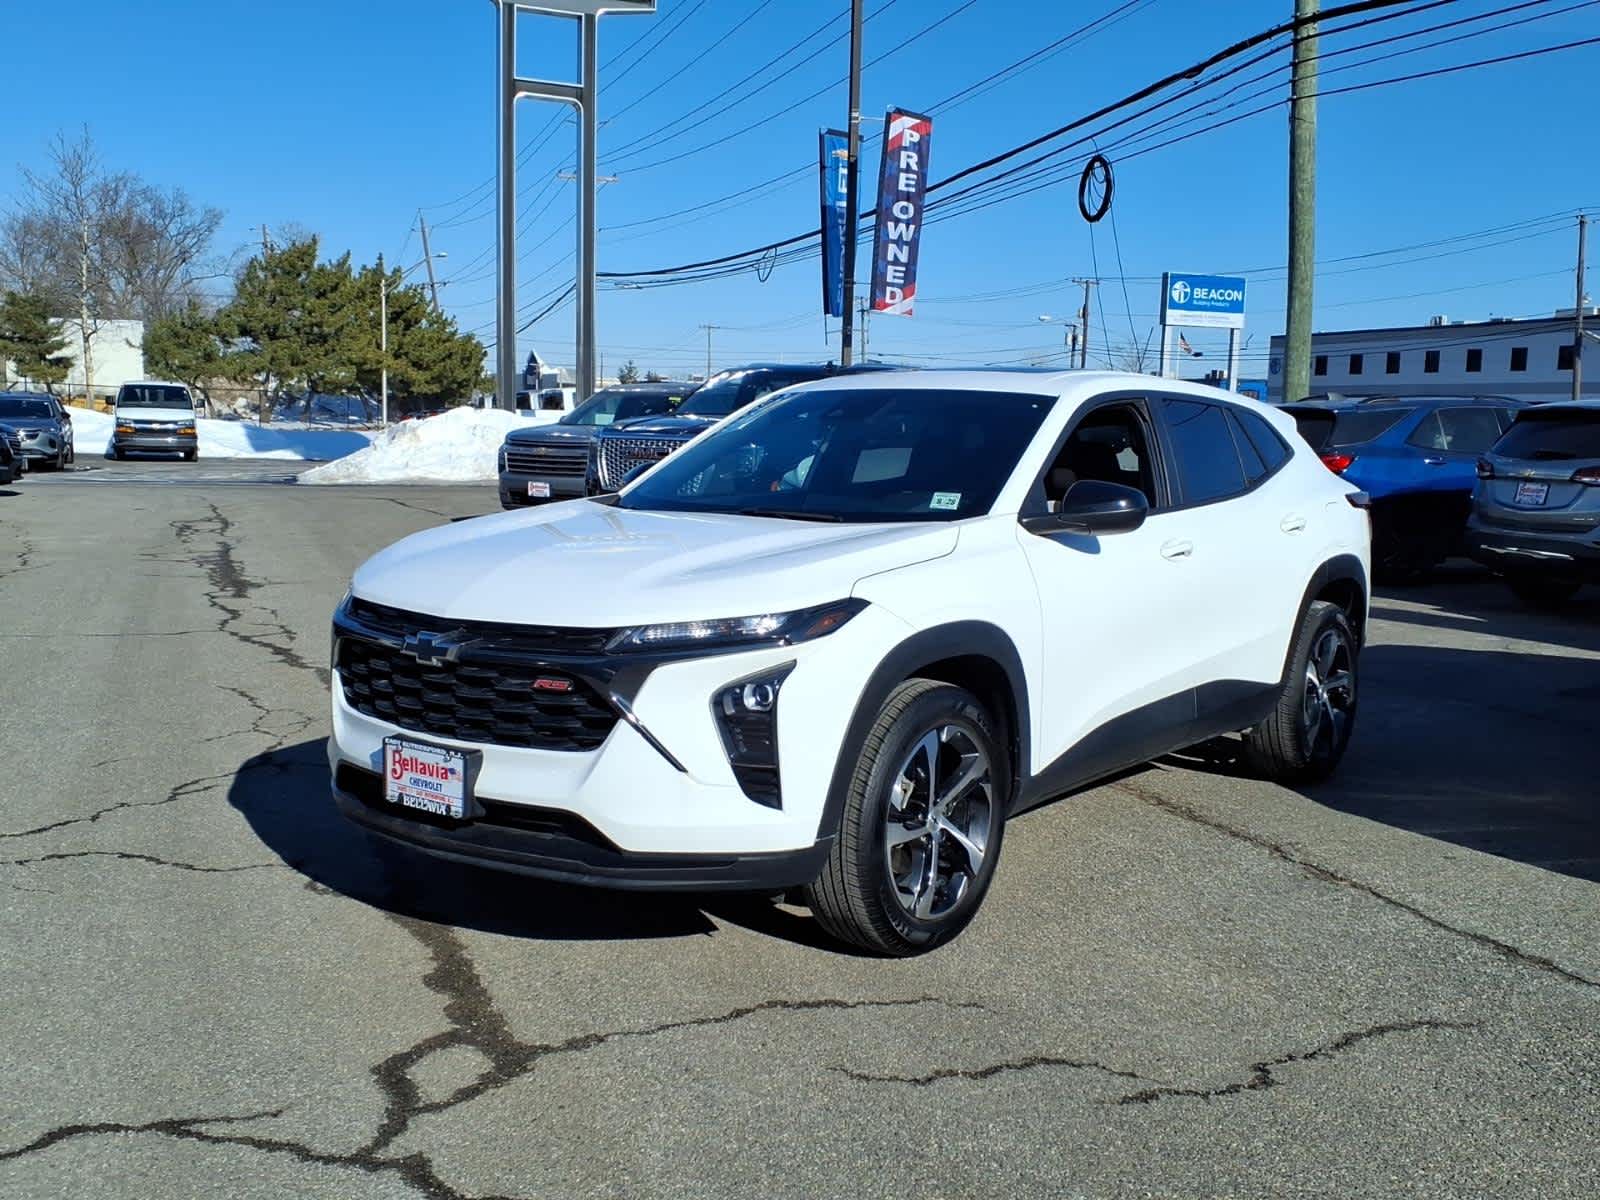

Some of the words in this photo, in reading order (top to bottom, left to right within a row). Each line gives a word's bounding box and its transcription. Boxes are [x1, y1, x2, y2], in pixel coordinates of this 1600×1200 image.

[897, 128, 921, 193] PRE
[884, 200, 916, 305] OWNED
[1193, 287, 1243, 302] BEACON
[534, 679, 570, 689] RS
[391, 749, 449, 780] Bellavia
[409, 776, 444, 793] CHEVROLET
[403, 794, 447, 816] BELLAVIA
